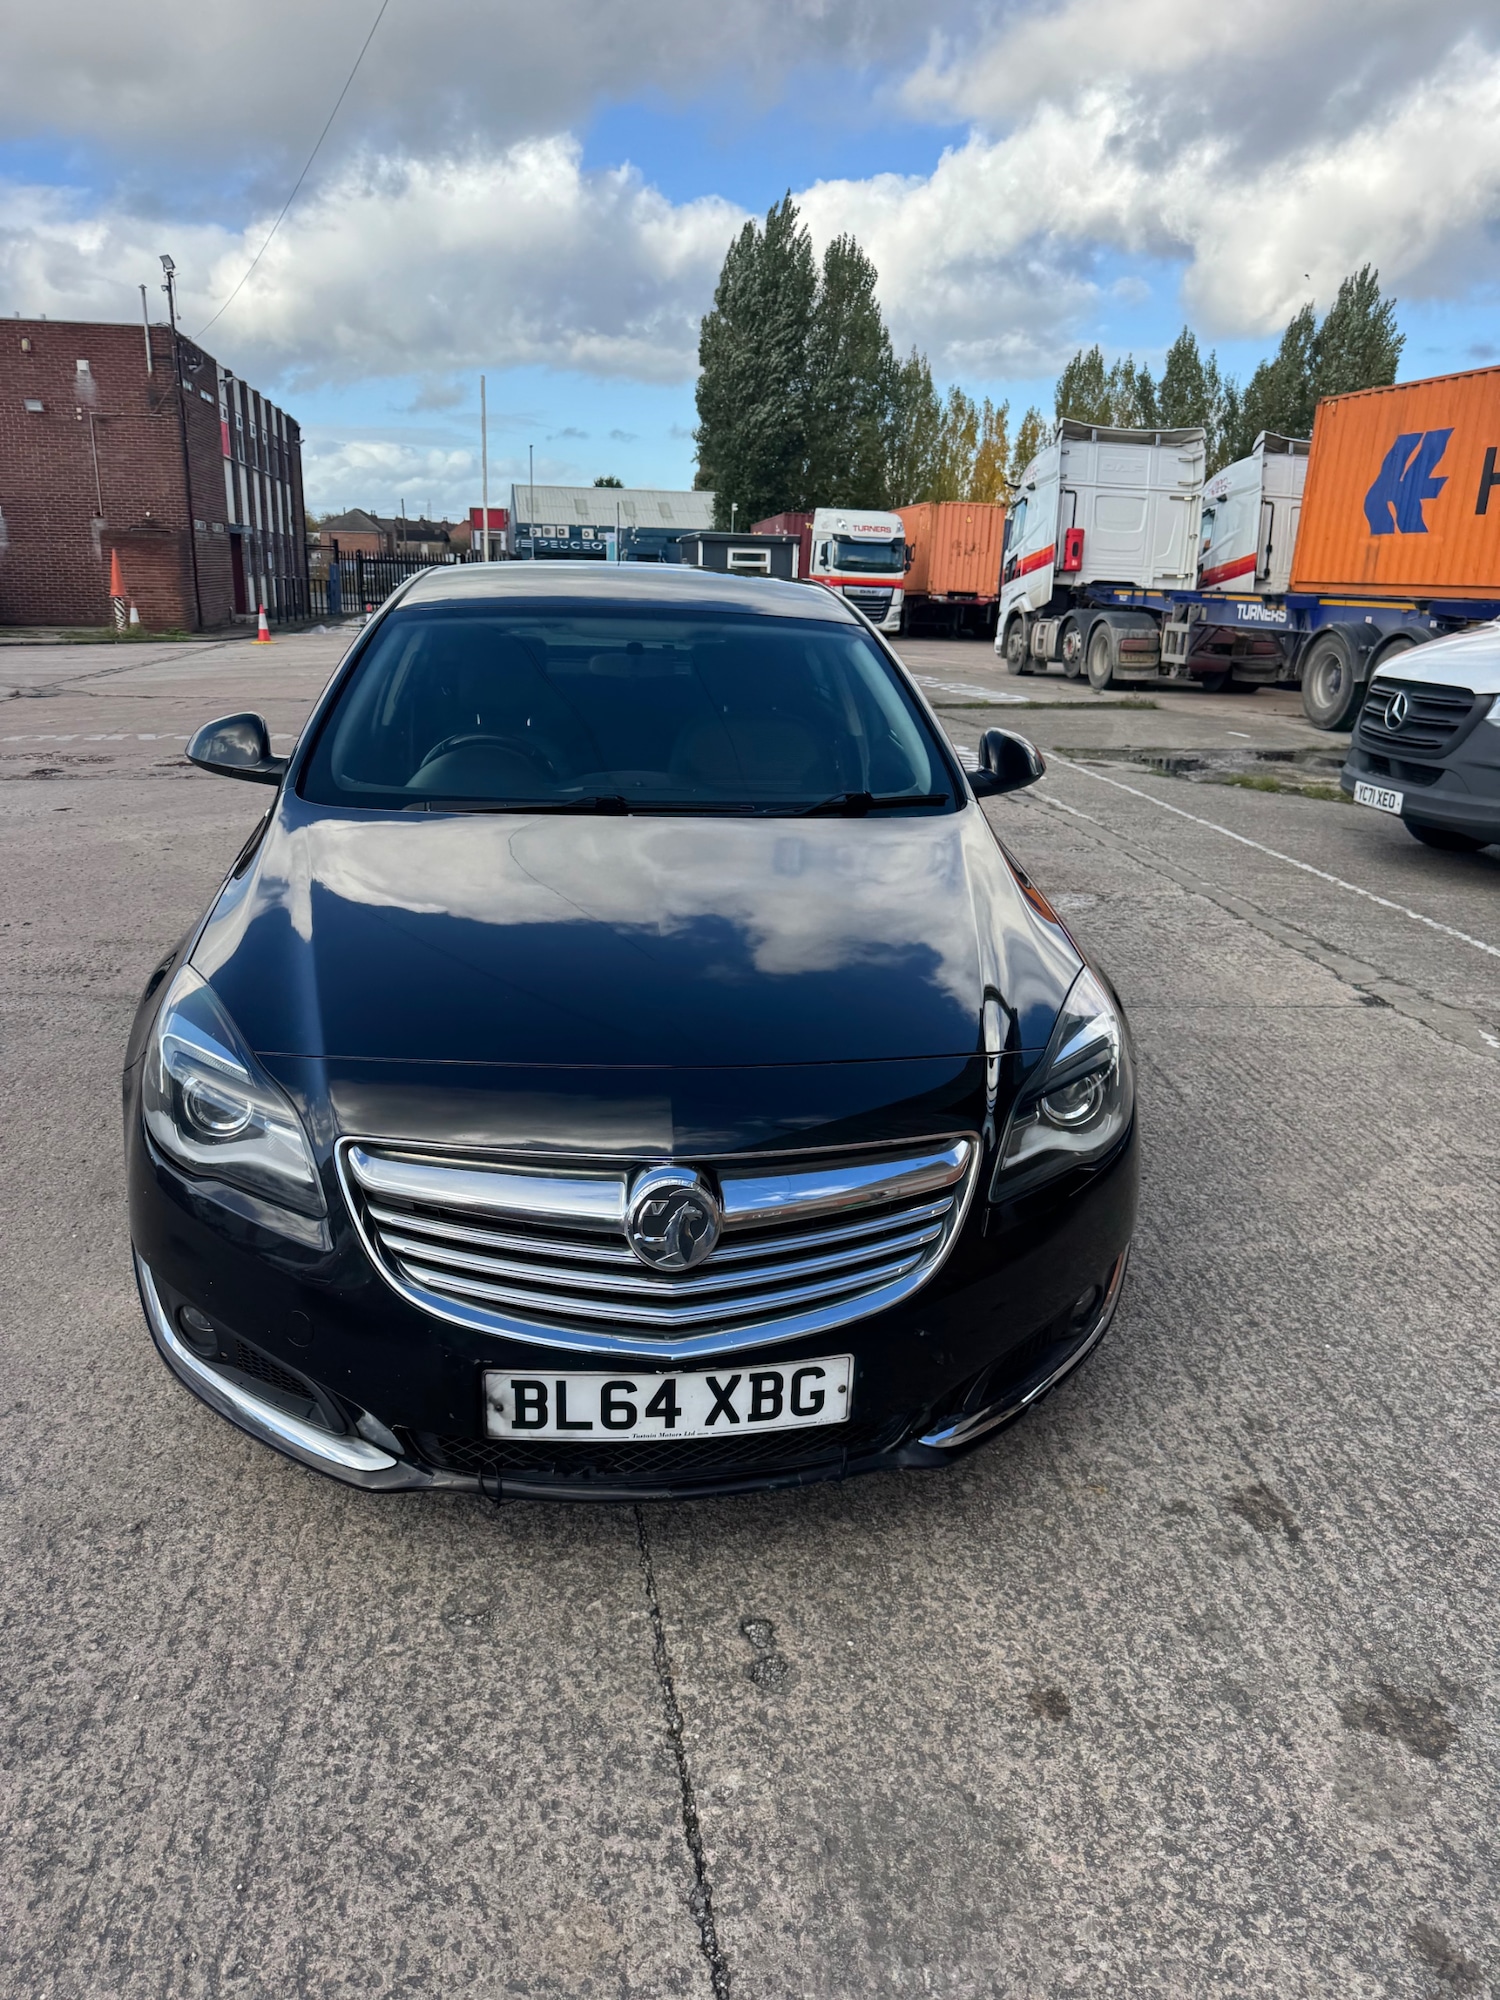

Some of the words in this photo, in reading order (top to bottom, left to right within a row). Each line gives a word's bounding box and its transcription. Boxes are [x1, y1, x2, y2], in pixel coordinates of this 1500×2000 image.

[853, 525, 891, 534] TURNERS
[539, 540, 607, 551] PEUGEO
[1236, 604, 1287, 623] TURNERS
[1359, 785, 1376, 804] YC71
[1376, 789, 1396, 809] XEO
[511, 1379, 681, 1430] BL64
[704, 1366, 826, 1426] XBG
